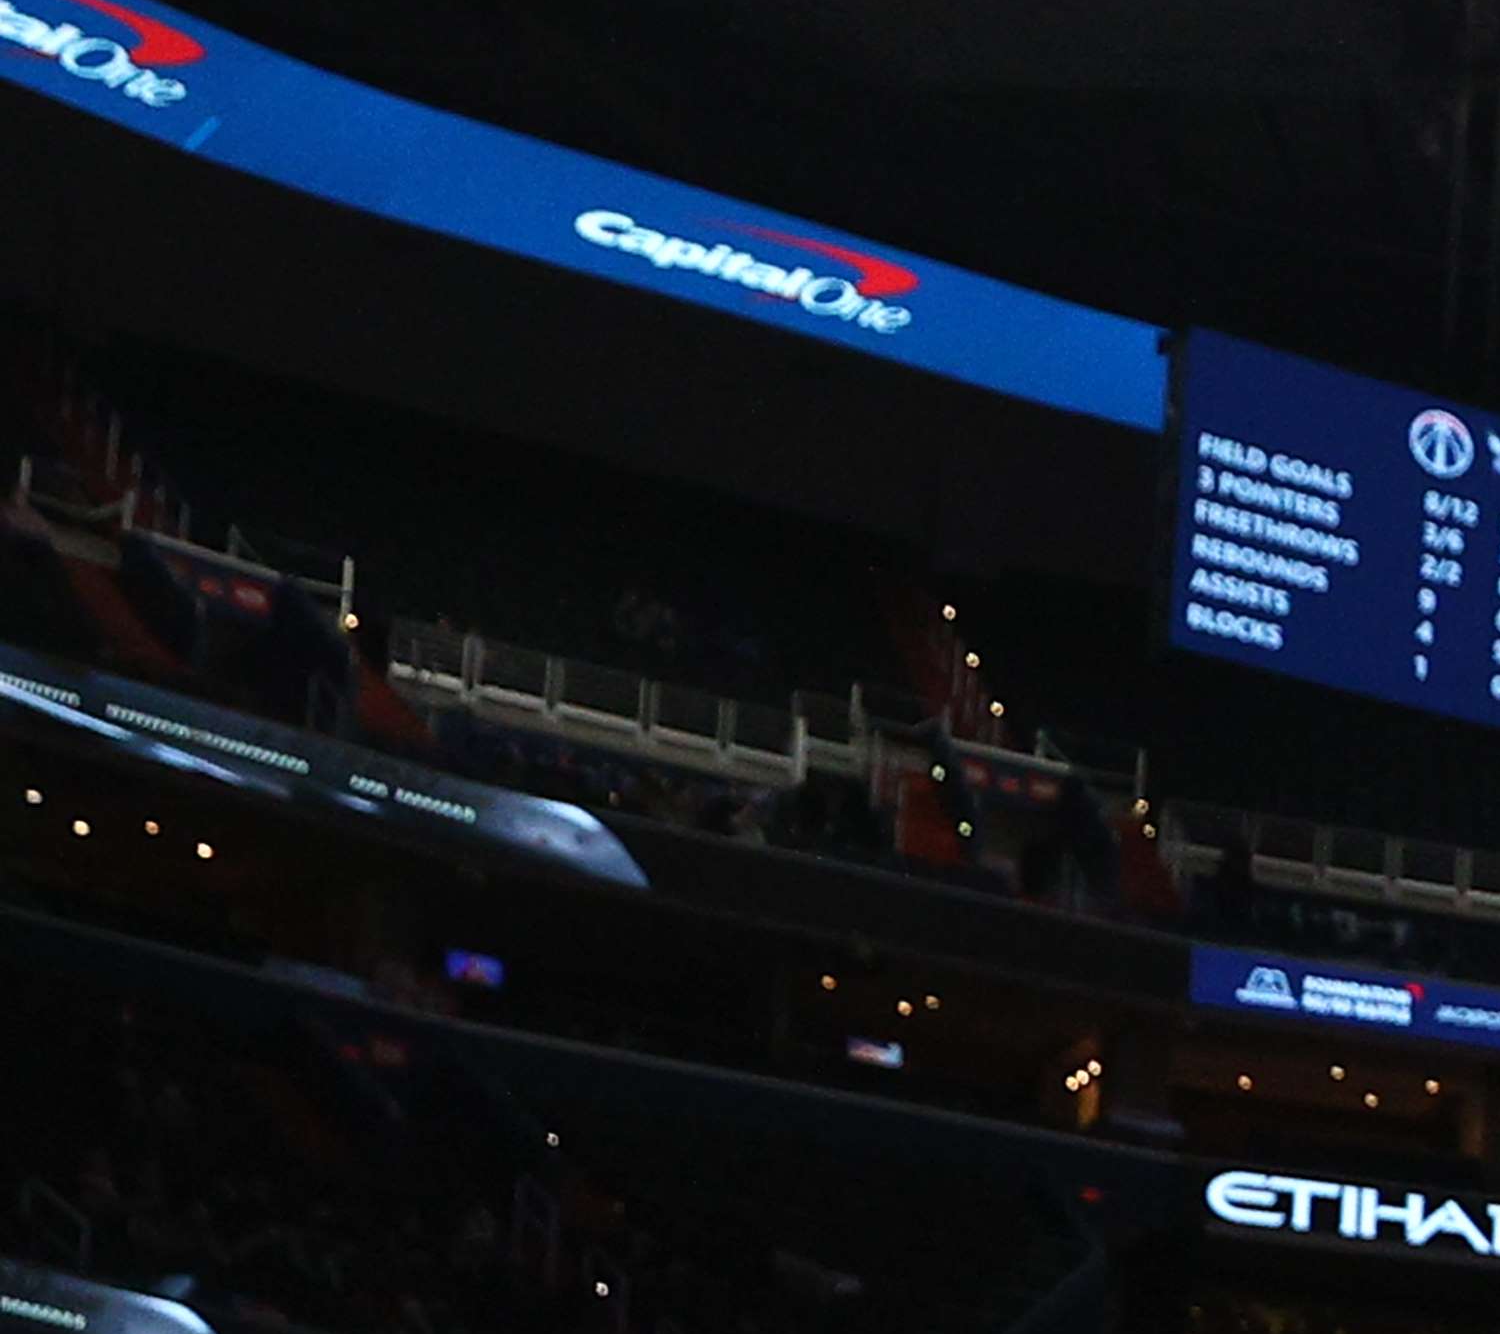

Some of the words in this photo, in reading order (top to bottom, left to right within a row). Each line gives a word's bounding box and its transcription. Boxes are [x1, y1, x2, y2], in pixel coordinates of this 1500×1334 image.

[1197, 464, 1216, 495] 3
[1217, 470, 1341, 530] POINTERS
[1198, 431, 1268, 475] FIELD
[1269, 453, 1354, 500] GOALS
[1188, 567, 1292, 617] ASSISTS
[1191, 531, 1330, 594] REBOUNDS
[1186, 601, 1285, 652] BLOCKS
